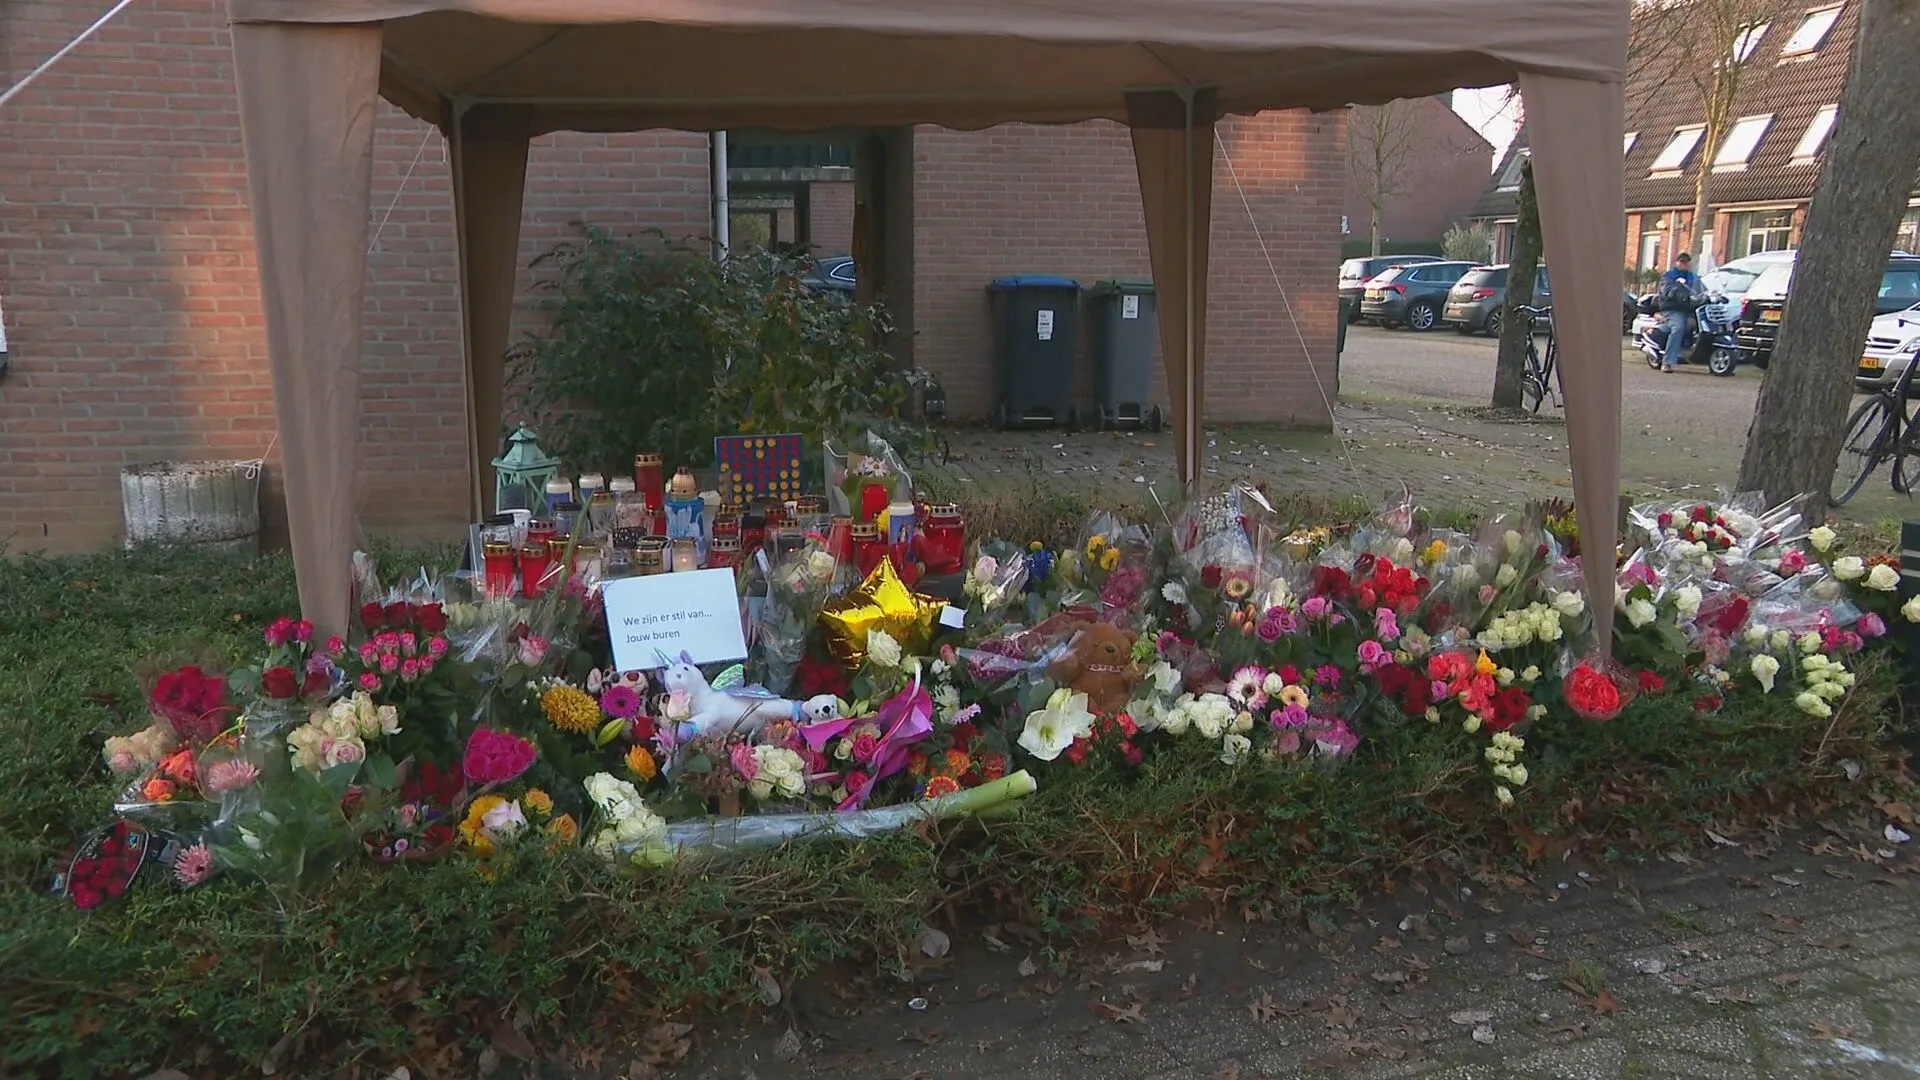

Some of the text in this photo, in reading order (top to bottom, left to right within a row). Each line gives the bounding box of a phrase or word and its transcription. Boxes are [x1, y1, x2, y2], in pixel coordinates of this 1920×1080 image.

[623, 610, 712, 626] We zijn er stil van...
[626, 630, 680, 643] Jouw buren
